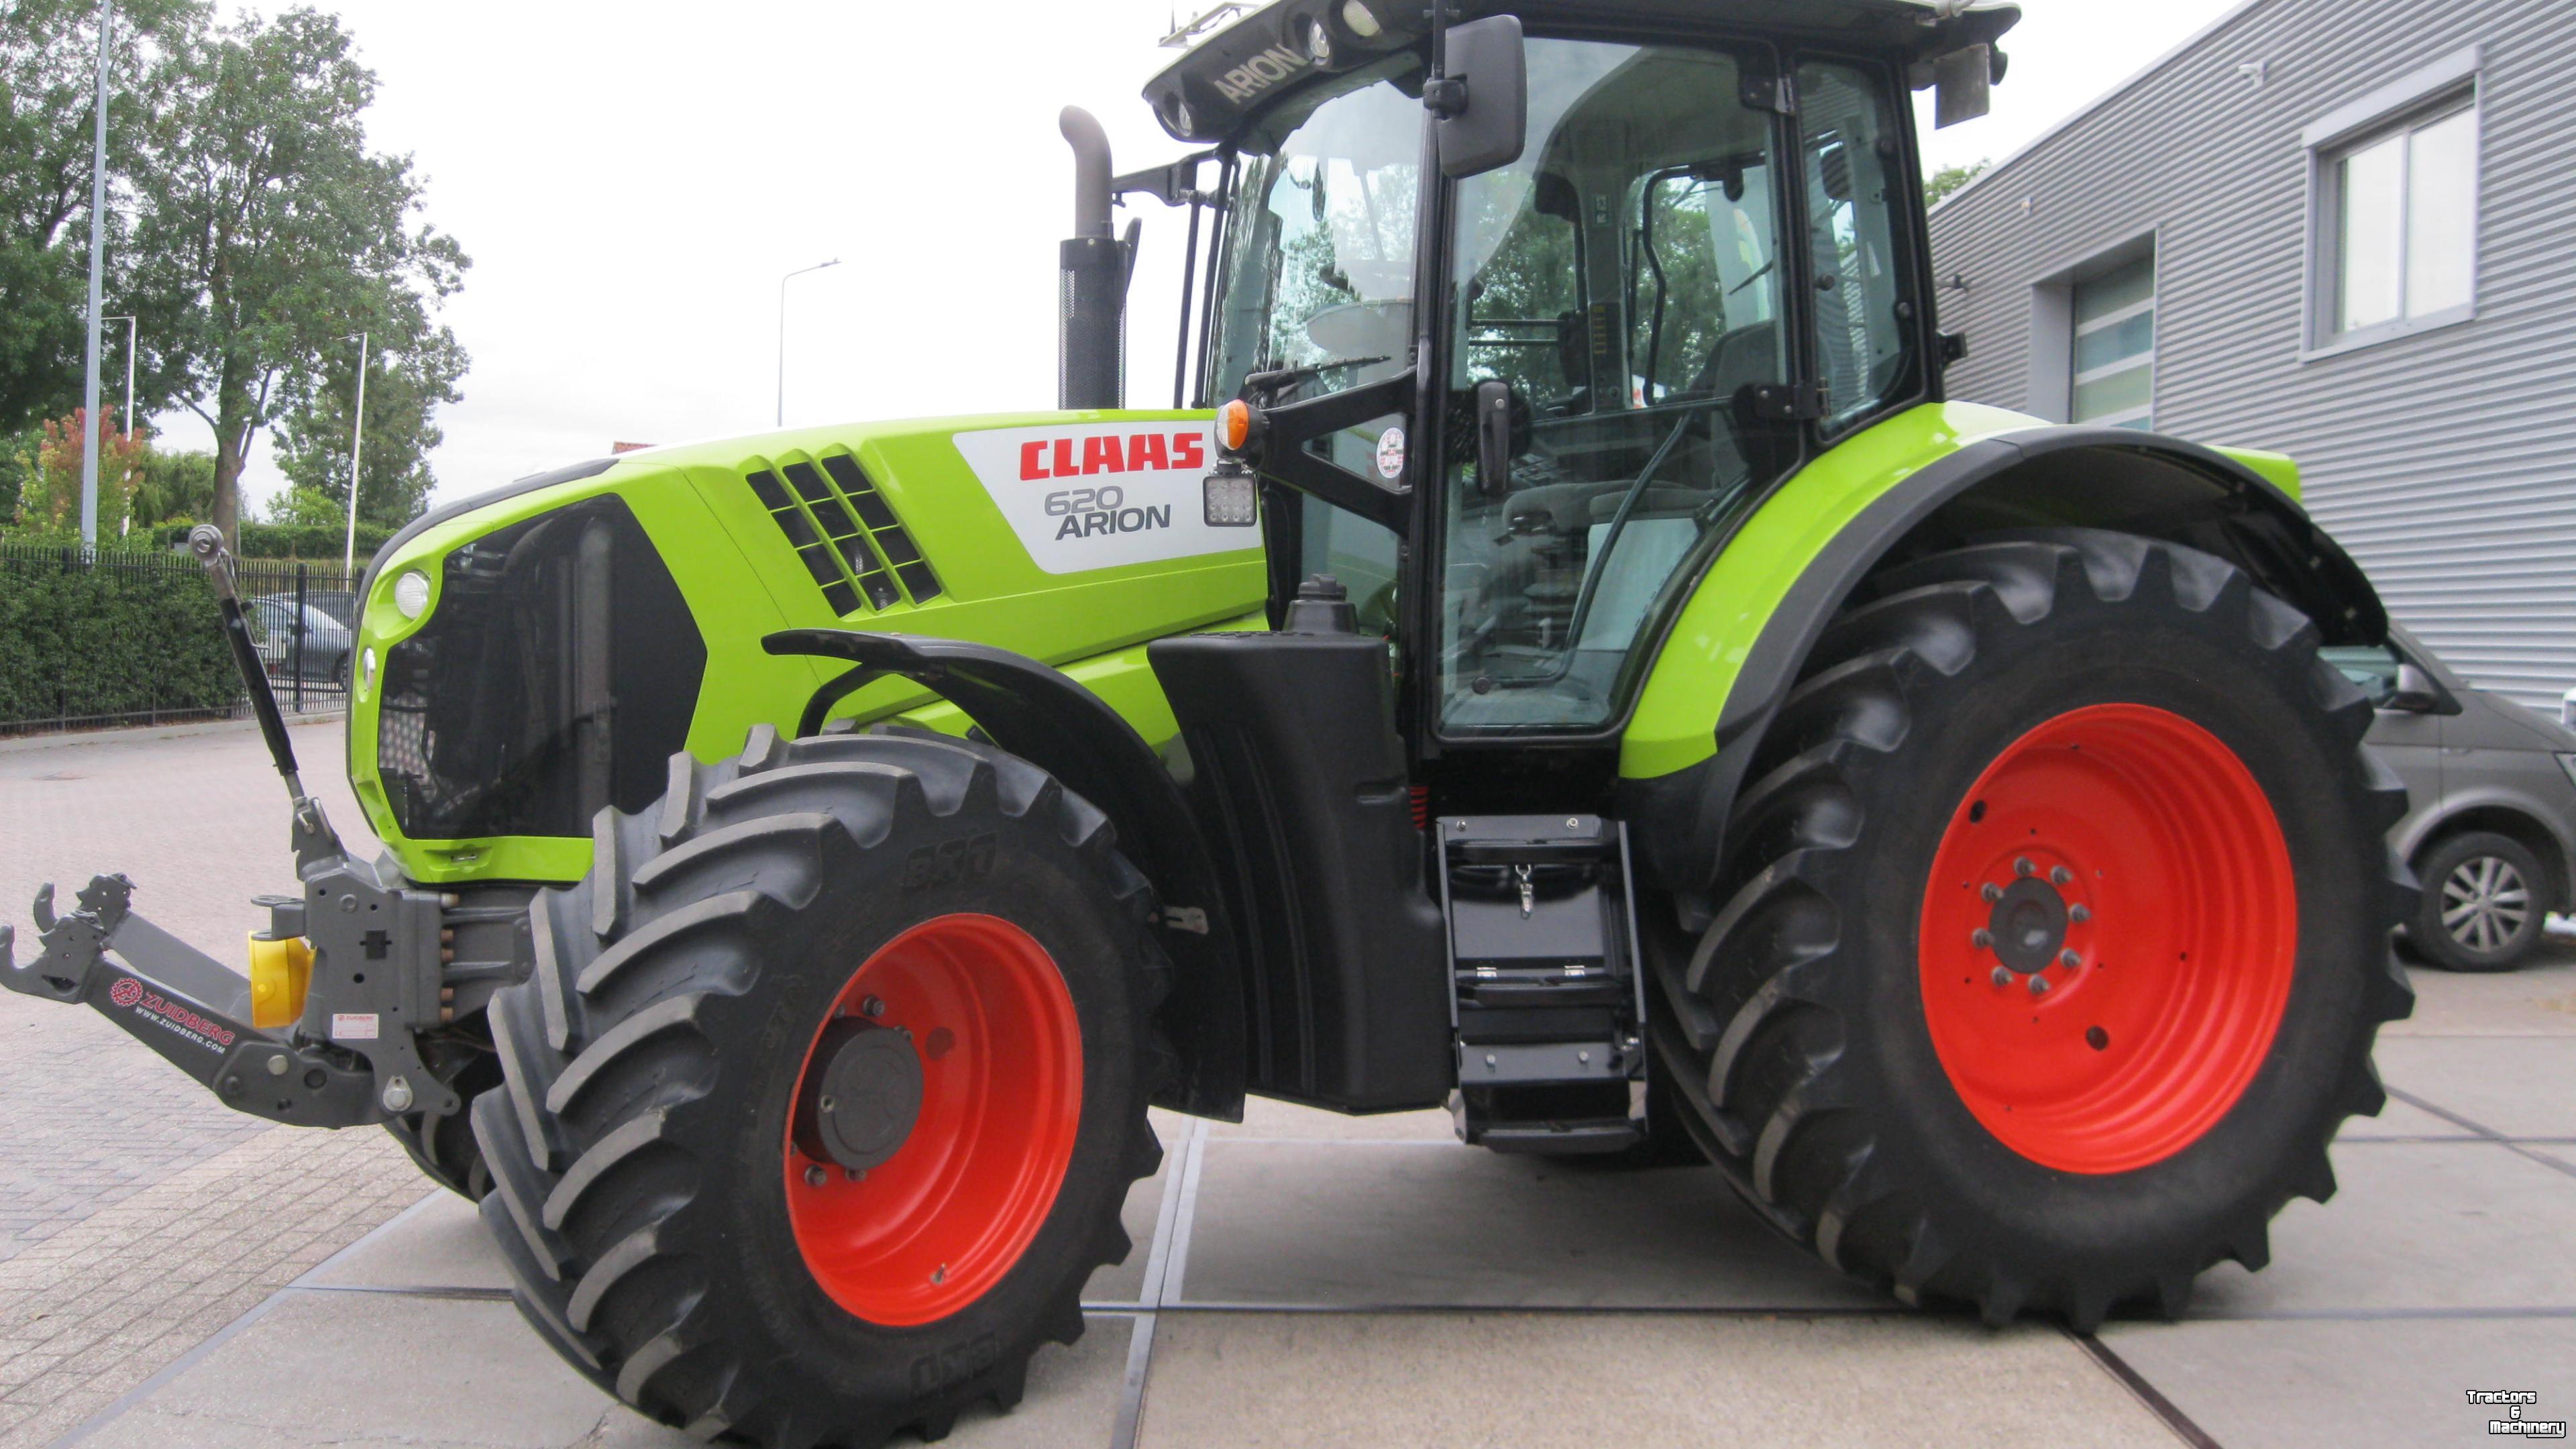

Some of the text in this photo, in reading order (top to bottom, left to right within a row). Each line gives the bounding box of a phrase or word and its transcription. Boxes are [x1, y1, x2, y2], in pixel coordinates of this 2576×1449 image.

[1214, 43, 1307, 104] ARION
[1020, 433, 1203, 480] CLAAS
[1044, 486, 1124, 516] 620
[1055, 504, 1171, 541] ARION
[136, 1006, 225, 1054] WWW.ZUIDBERG.COM
[140, 991, 235, 1046] ZUIDBERG
